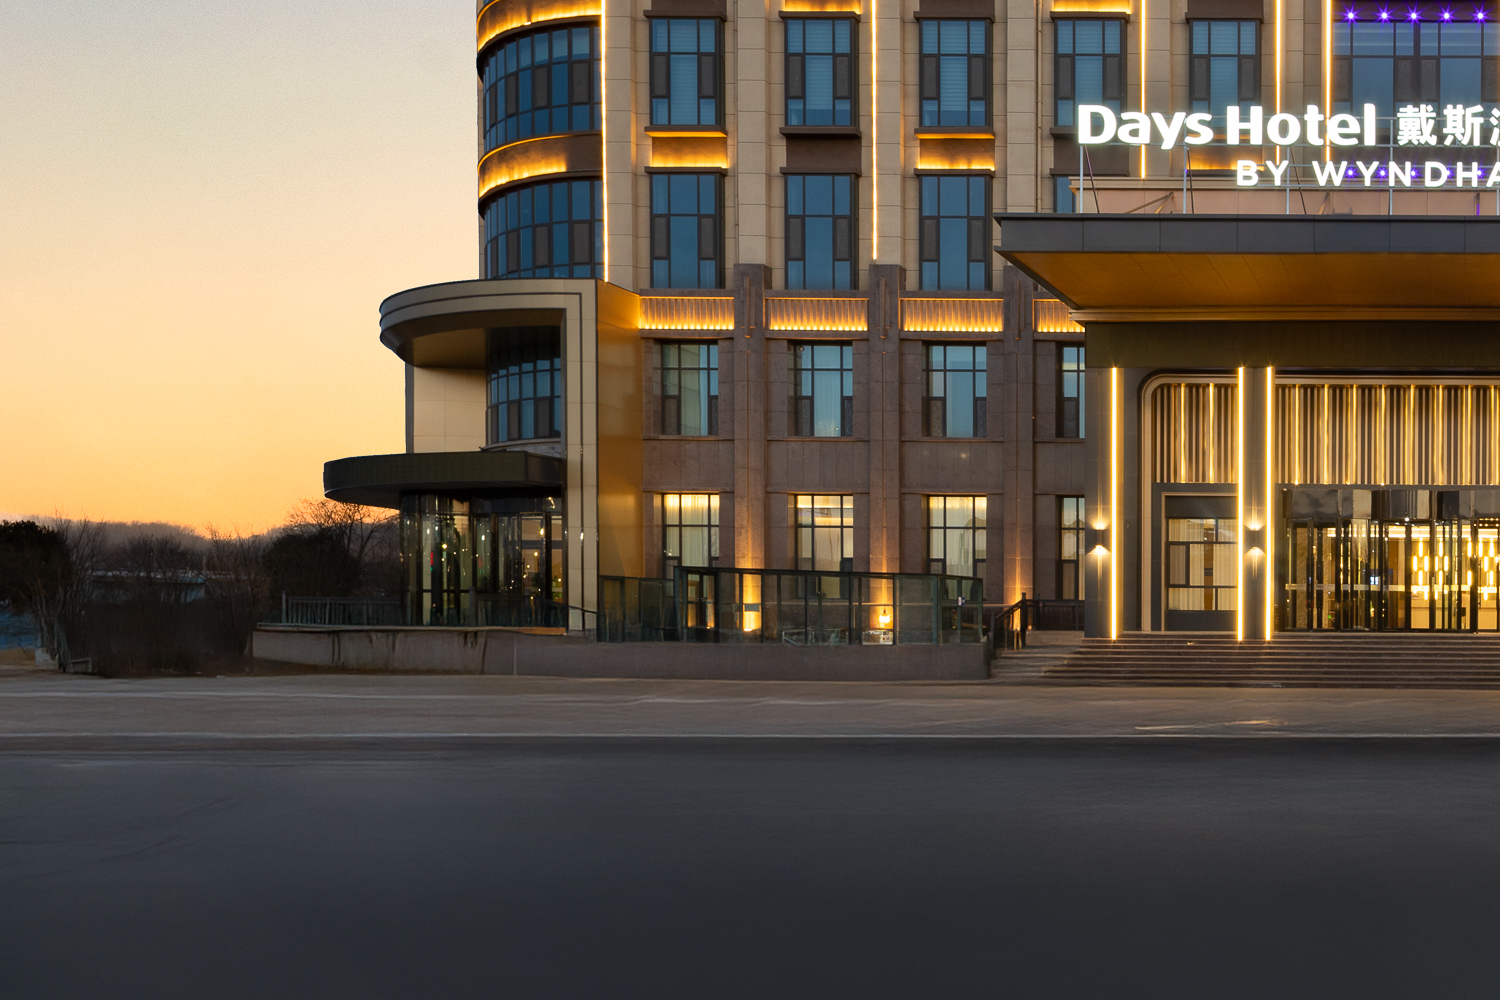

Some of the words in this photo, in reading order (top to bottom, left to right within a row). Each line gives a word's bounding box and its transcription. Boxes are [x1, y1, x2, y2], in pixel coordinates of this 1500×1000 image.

[1077, 104, 1213, 149] Days
[1226, 103, 1376, 146] Hotel
[1235, 160, 1290, 187] BY
